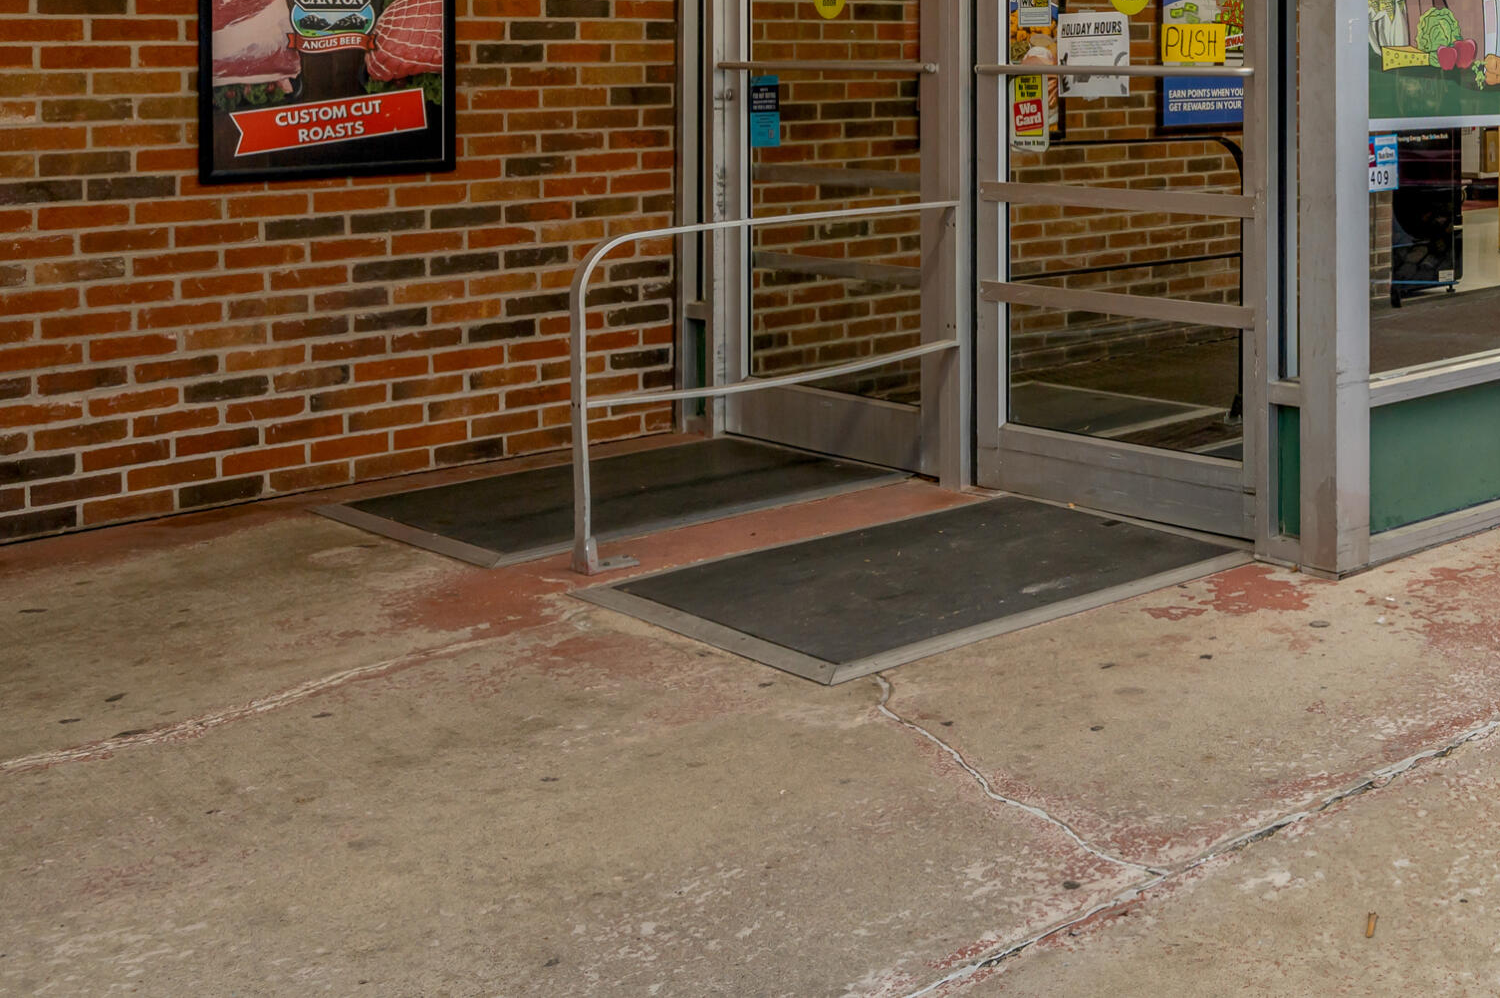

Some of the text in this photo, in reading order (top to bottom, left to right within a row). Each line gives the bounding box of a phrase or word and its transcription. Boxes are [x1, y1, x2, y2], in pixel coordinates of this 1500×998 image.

[1061, 20, 1122, 36] HOLIDAY HOURS
[302, 36, 362, 50] ANGUS BEEF
[1166, 26, 1217, 59] PUSH
[1168, 90, 1186, 99] EARN
[1187, 89, 1210, 98] POINTS
[1211, 88, 1230, 97] WHEN
[1019, 102, 1037, 115] We
[1168, 100, 1242, 112] GET REWARDS IN YOUR
[275, 100, 382, 127] CUSTOM CUT
[1015, 112, 1042, 126] Card
[298, 121, 365, 142] ROASTS
[1371, 170, 1389, 185] 409
